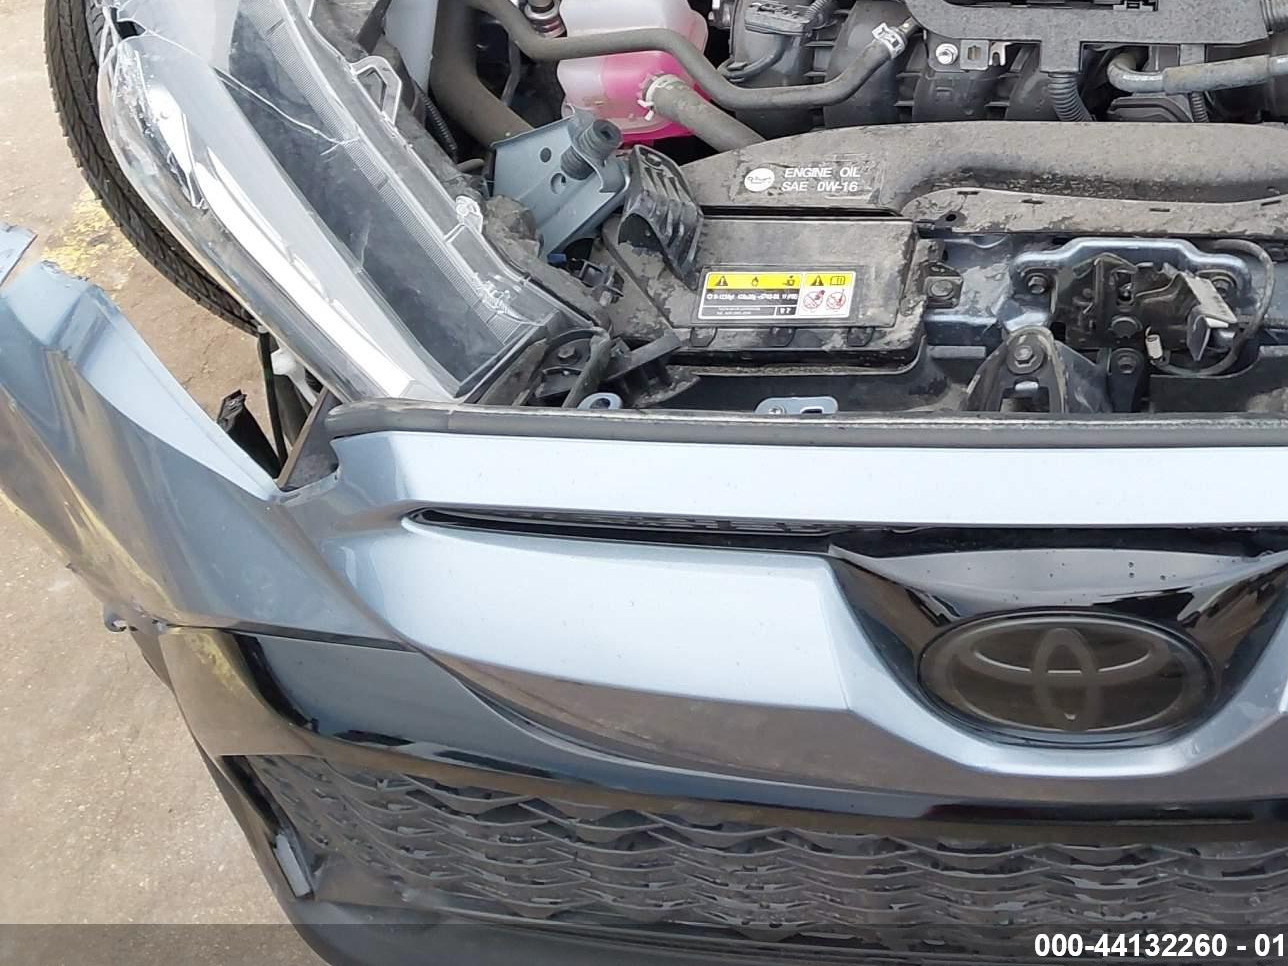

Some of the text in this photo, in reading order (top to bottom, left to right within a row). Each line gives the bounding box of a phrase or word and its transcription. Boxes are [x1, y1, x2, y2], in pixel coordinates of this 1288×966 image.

[784, 166, 862, 178] ENGINE OIL
[781, 181, 859, 192] SAE 0W-16
